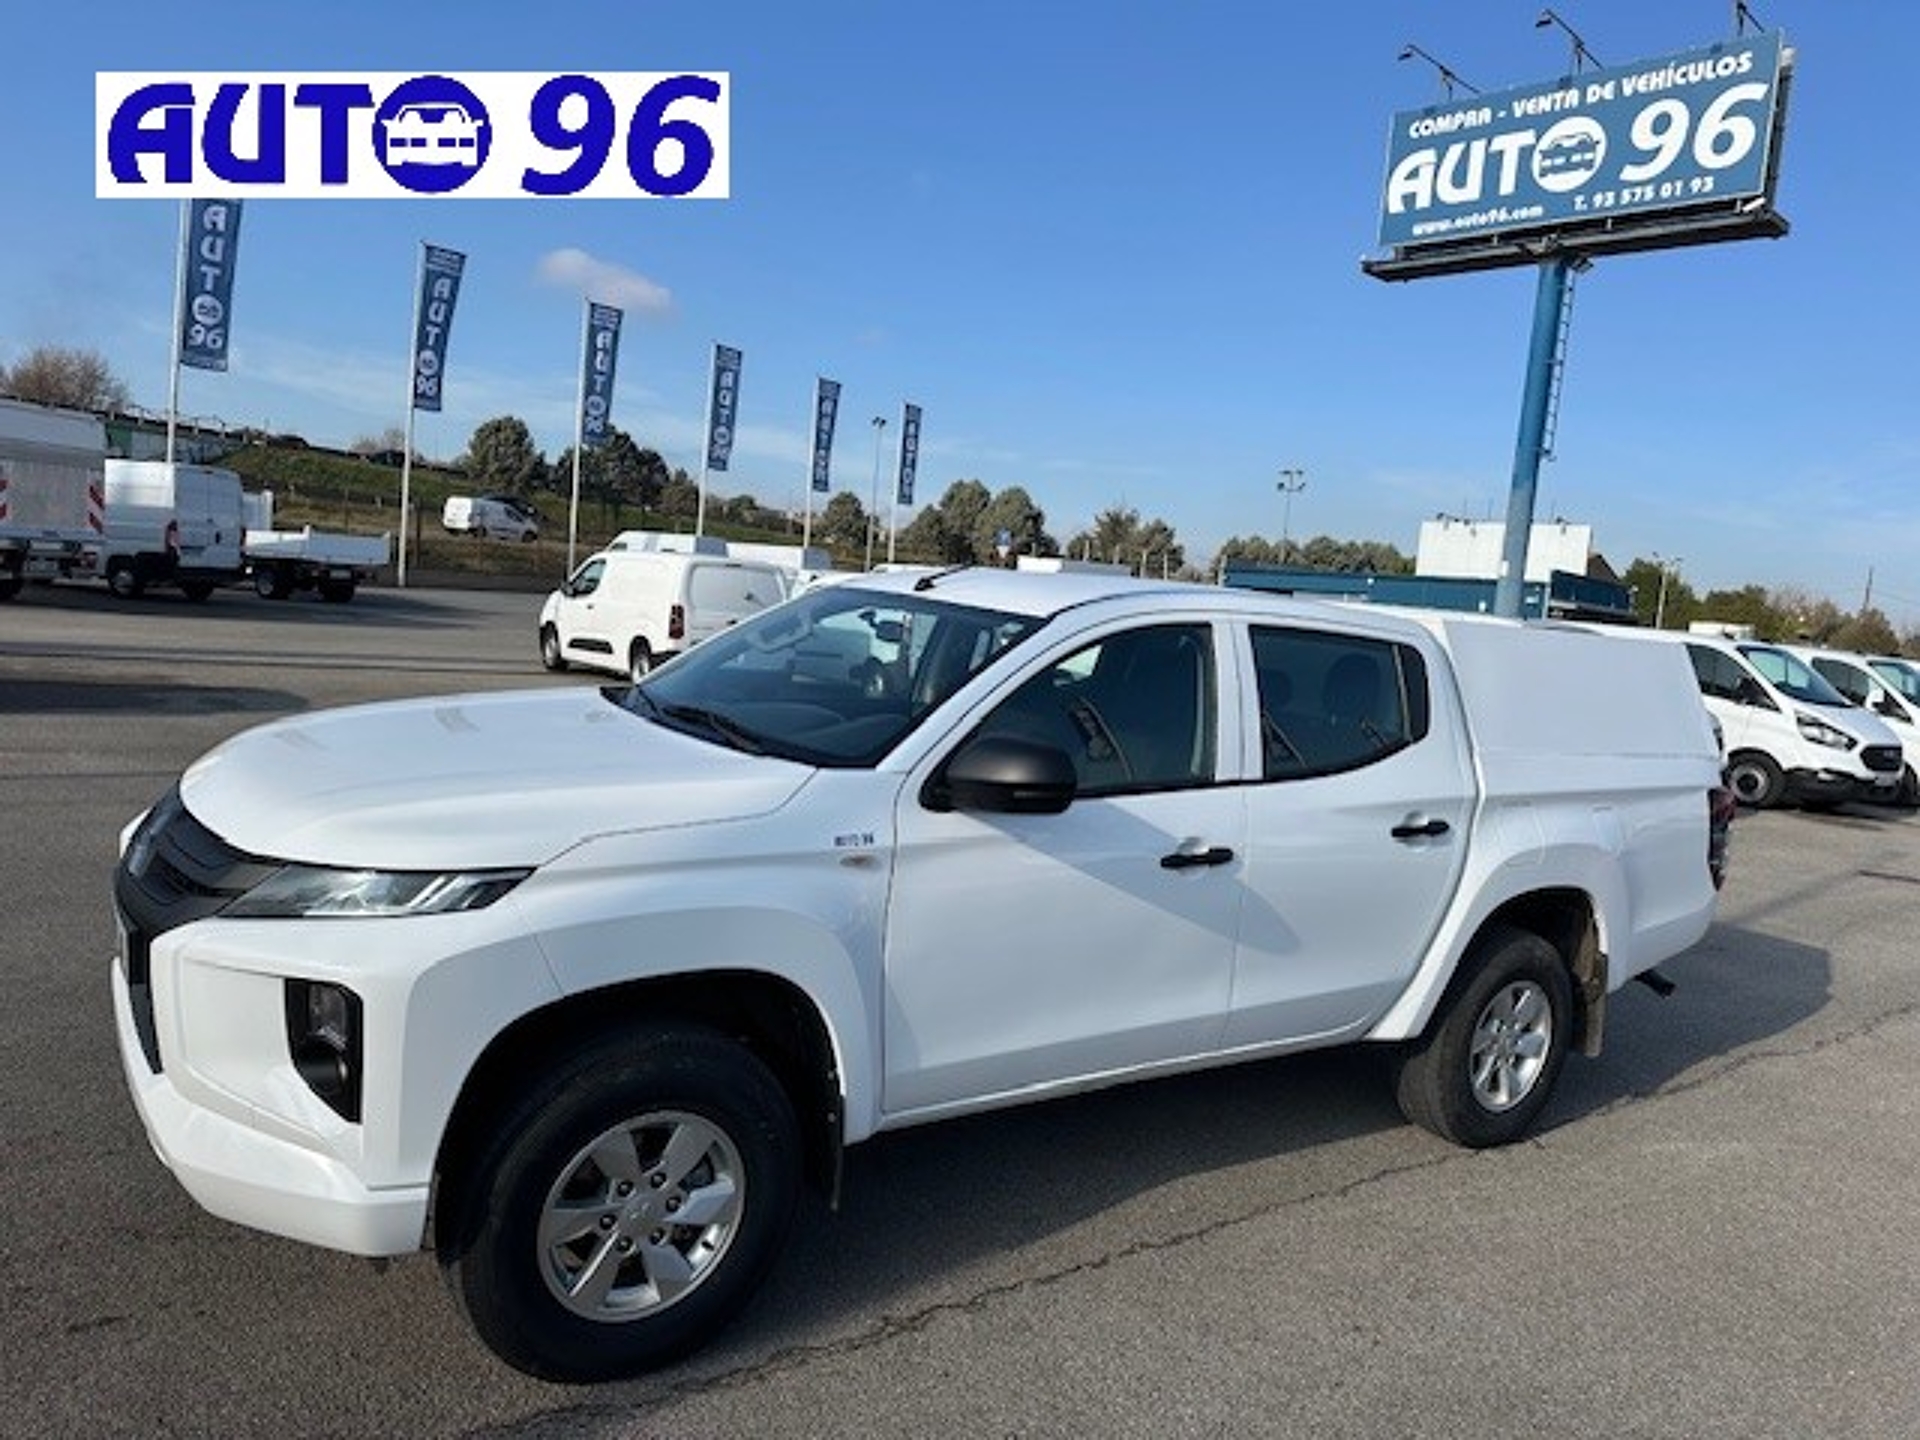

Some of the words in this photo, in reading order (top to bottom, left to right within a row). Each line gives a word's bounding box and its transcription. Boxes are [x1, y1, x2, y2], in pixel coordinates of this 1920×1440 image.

[1409, 107, 1492, 139] COMPRA
[1512, 88, 1579, 118] VENTA
[1586, 81, 1616, 103] DE
[1622, 52, 1753, 97] VEHÍCULOS
[1388, 116, 1607, 214] AUTO
[1619, 83, 1769, 182] 96
[1412, 205, 1543, 236] www.auto96.com
[1593, 191, 1615, 207] 93
[1620, 186, 1655, 204] 575
[1660, 180, 1684, 198] 01
[1690, 176, 1714, 194] 93
[192, 205, 228, 326] AUTO
[189, 323, 224, 349] 96
[419, 277, 452, 376] AUTO
[416, 374, 438, 397] 96
